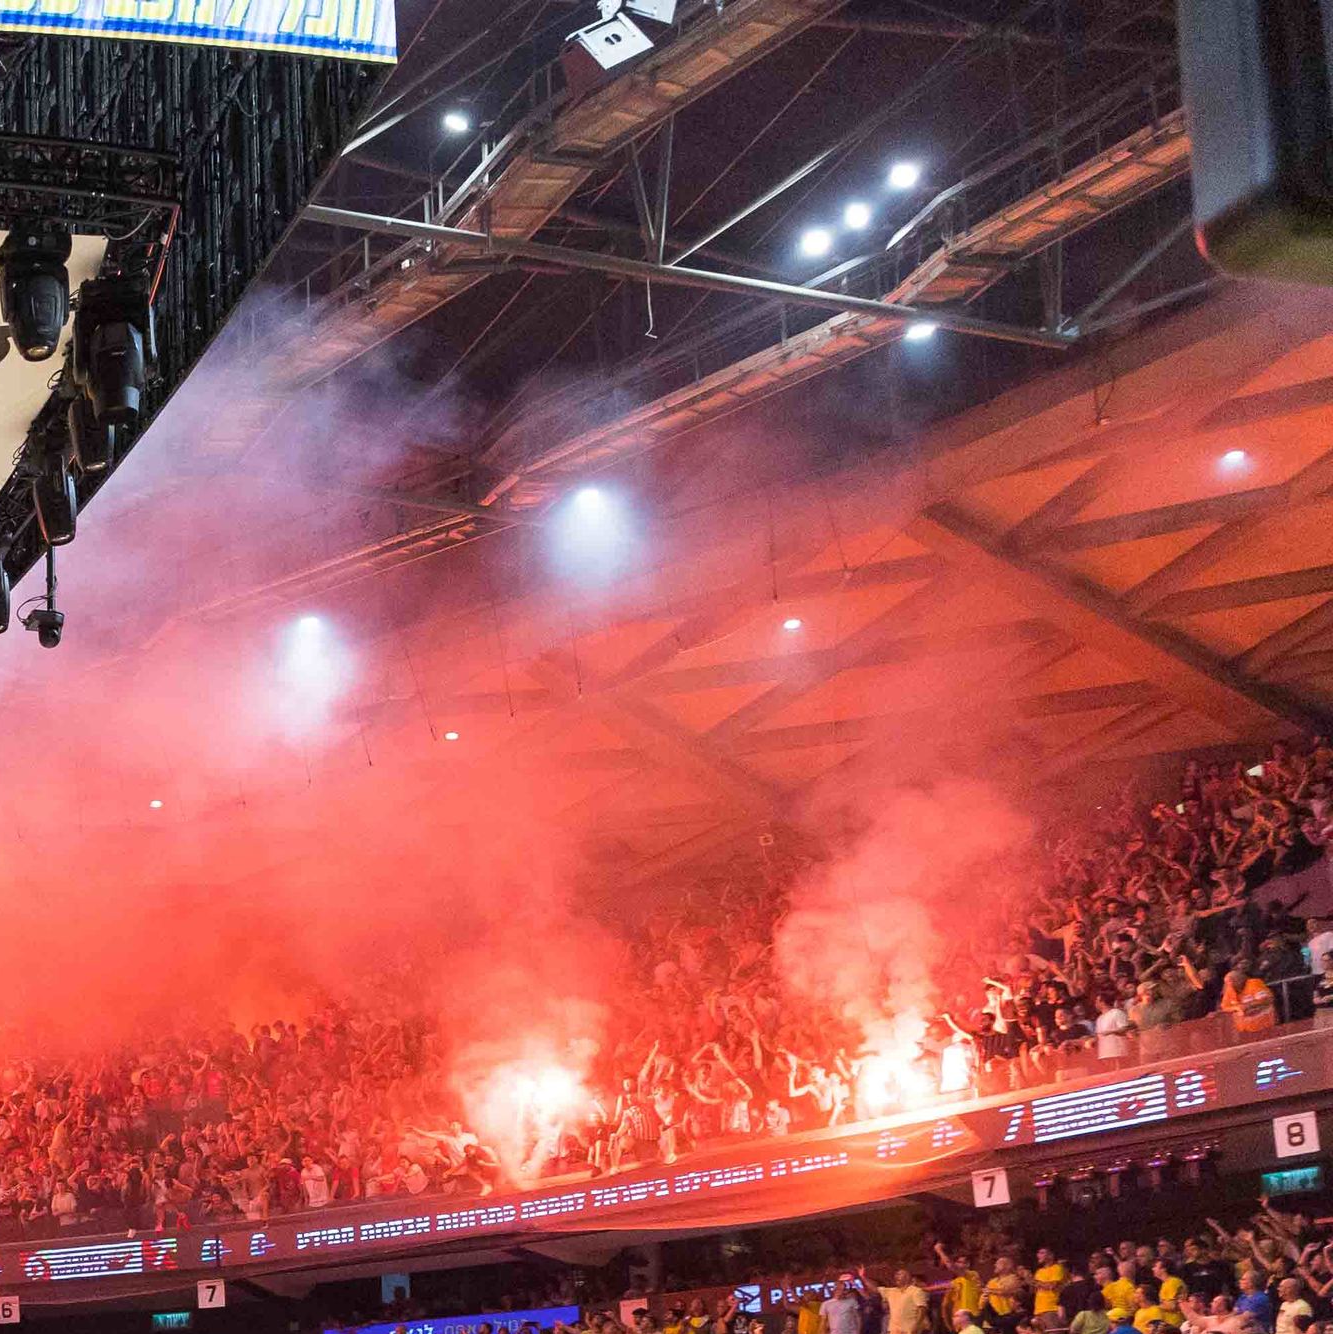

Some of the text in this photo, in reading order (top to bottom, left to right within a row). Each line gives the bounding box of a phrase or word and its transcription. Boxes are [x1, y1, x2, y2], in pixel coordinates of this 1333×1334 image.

[1287, 1122, 1305, 1147] 8
[982, 1176, 995, 1199] 7
[205, 1285, 216, 1302] 7
[1, 1301, 13, 1318] 6
